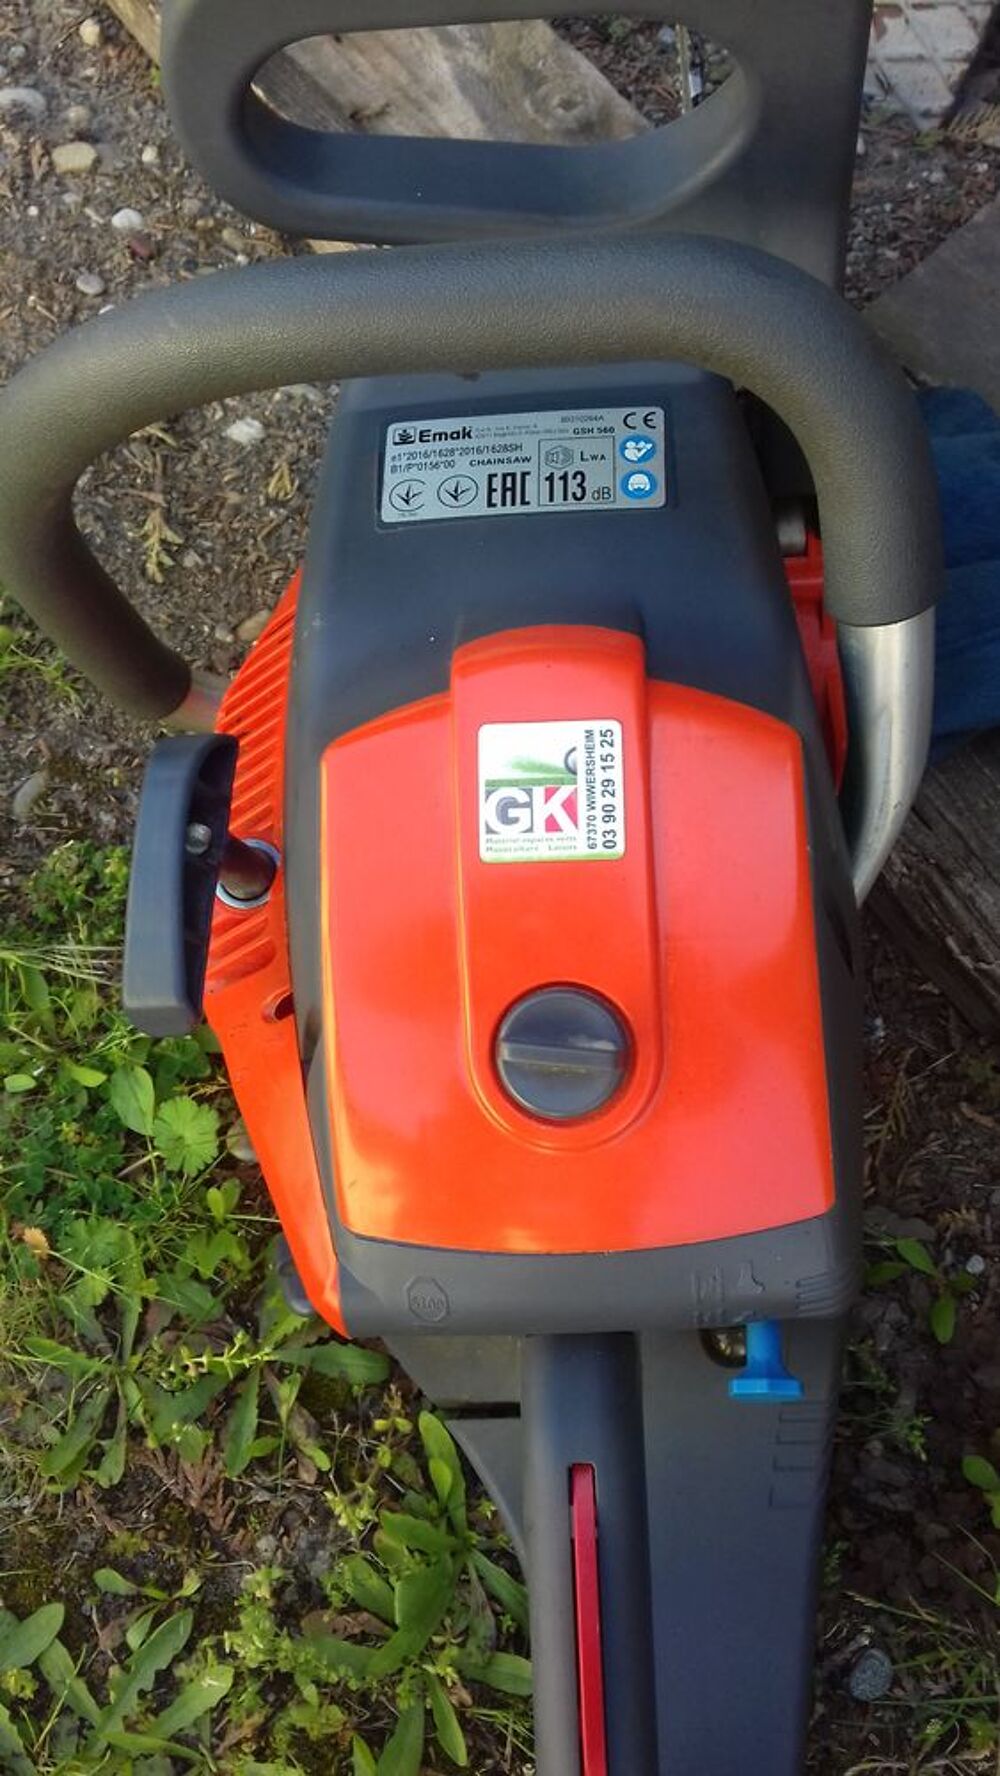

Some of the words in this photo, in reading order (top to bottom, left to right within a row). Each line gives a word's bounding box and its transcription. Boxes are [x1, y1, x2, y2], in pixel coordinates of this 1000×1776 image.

[622, 411, 657, 430] CE
[418, 426, 473, 443] Emak
[573, 427, 594, 436] GSH
[597, 426, 615, 434] 560
[468, 456, 532, 467] CHAINSAW
[486, 471, 531, 508] EAC
[544, 470, 587, 503] 113
[591, 486, 612, 501] dB
[599, 729, 615, 749] 25
[584, 729, 596, 812] WIWERSHEIM
[600, 753, 616, 773] 15
[600, 779, 616, 799] 29
[485, 786, 578, 835] GK
[601, 804, 616, 824] 90
[585, 814, 598, 850] 67370
[601, 829, 617, 850] 03
